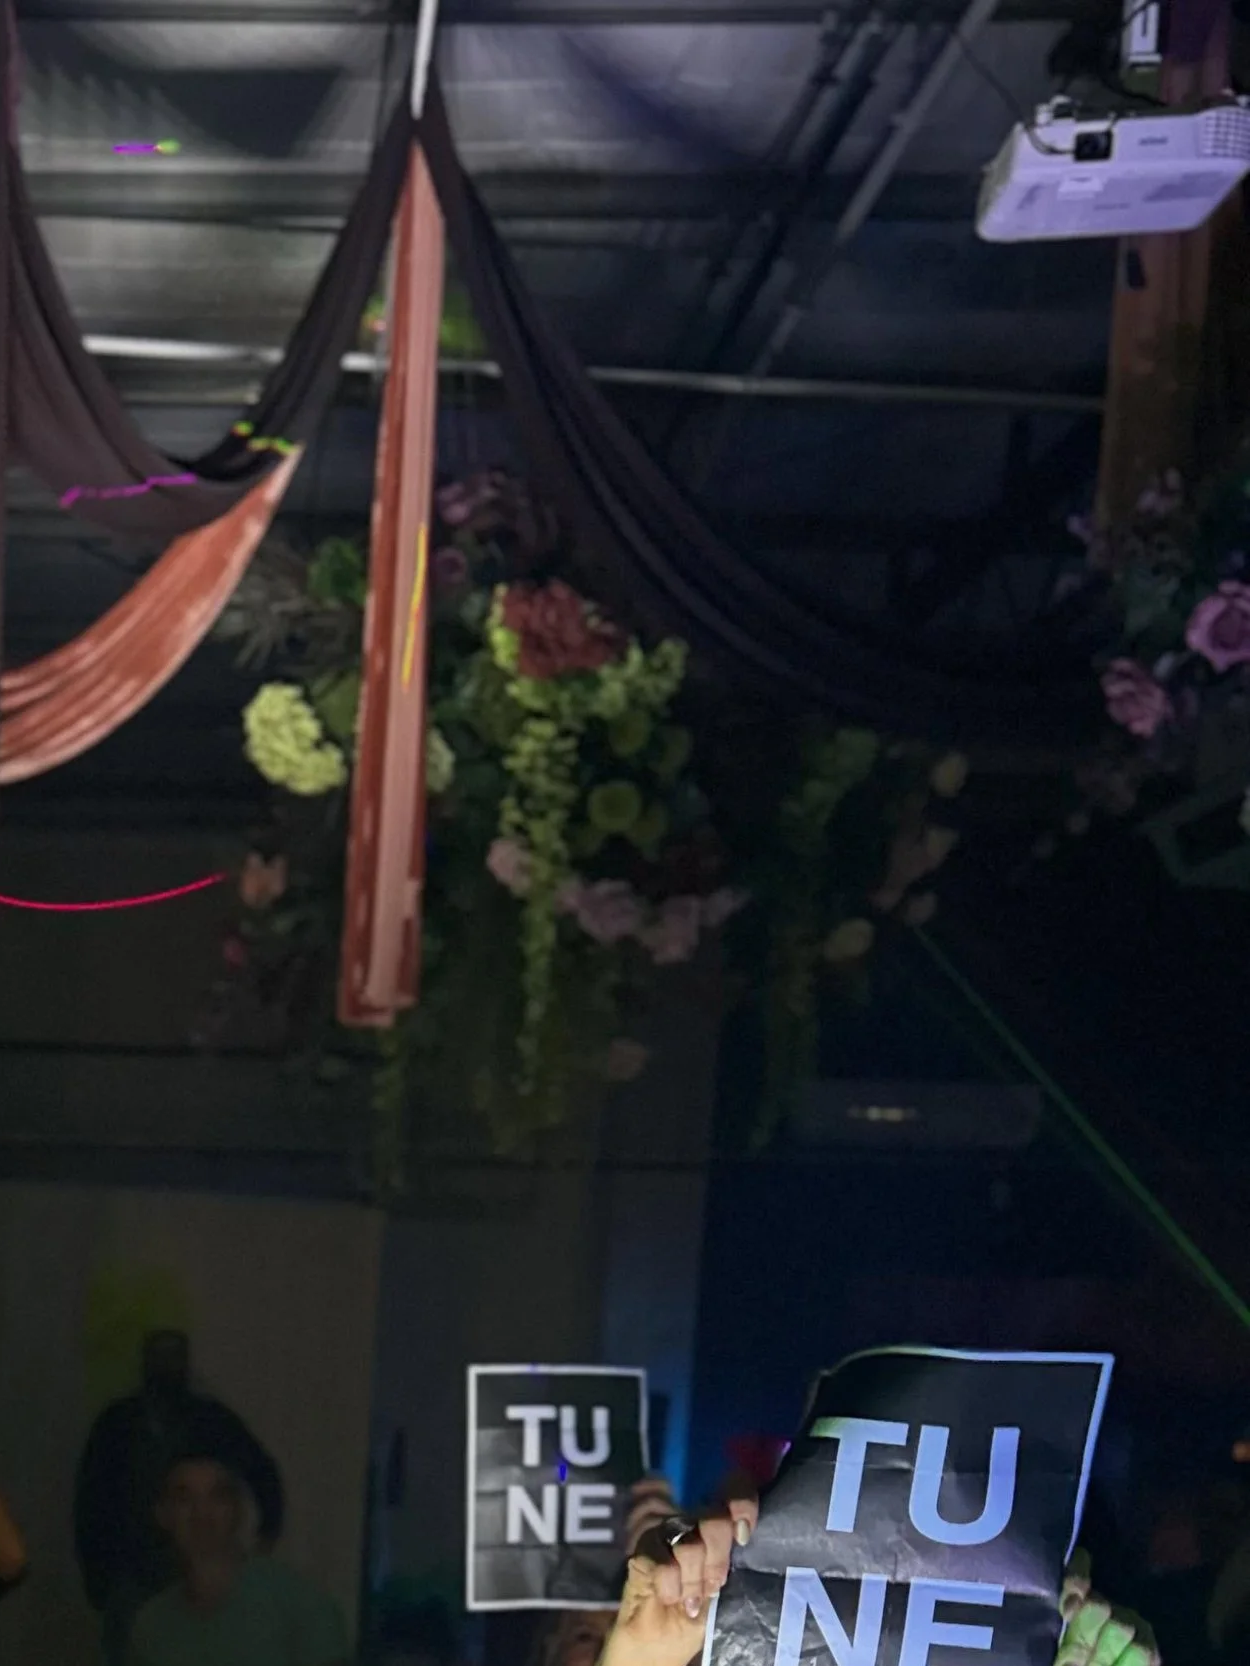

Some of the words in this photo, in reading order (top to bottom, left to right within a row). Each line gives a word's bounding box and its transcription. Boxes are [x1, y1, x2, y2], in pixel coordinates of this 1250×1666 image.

[505, 1405, 610, 1467] TU
[809, 1417, 1021, 1545] TU
[505, 1484, 615, 1544] NE
